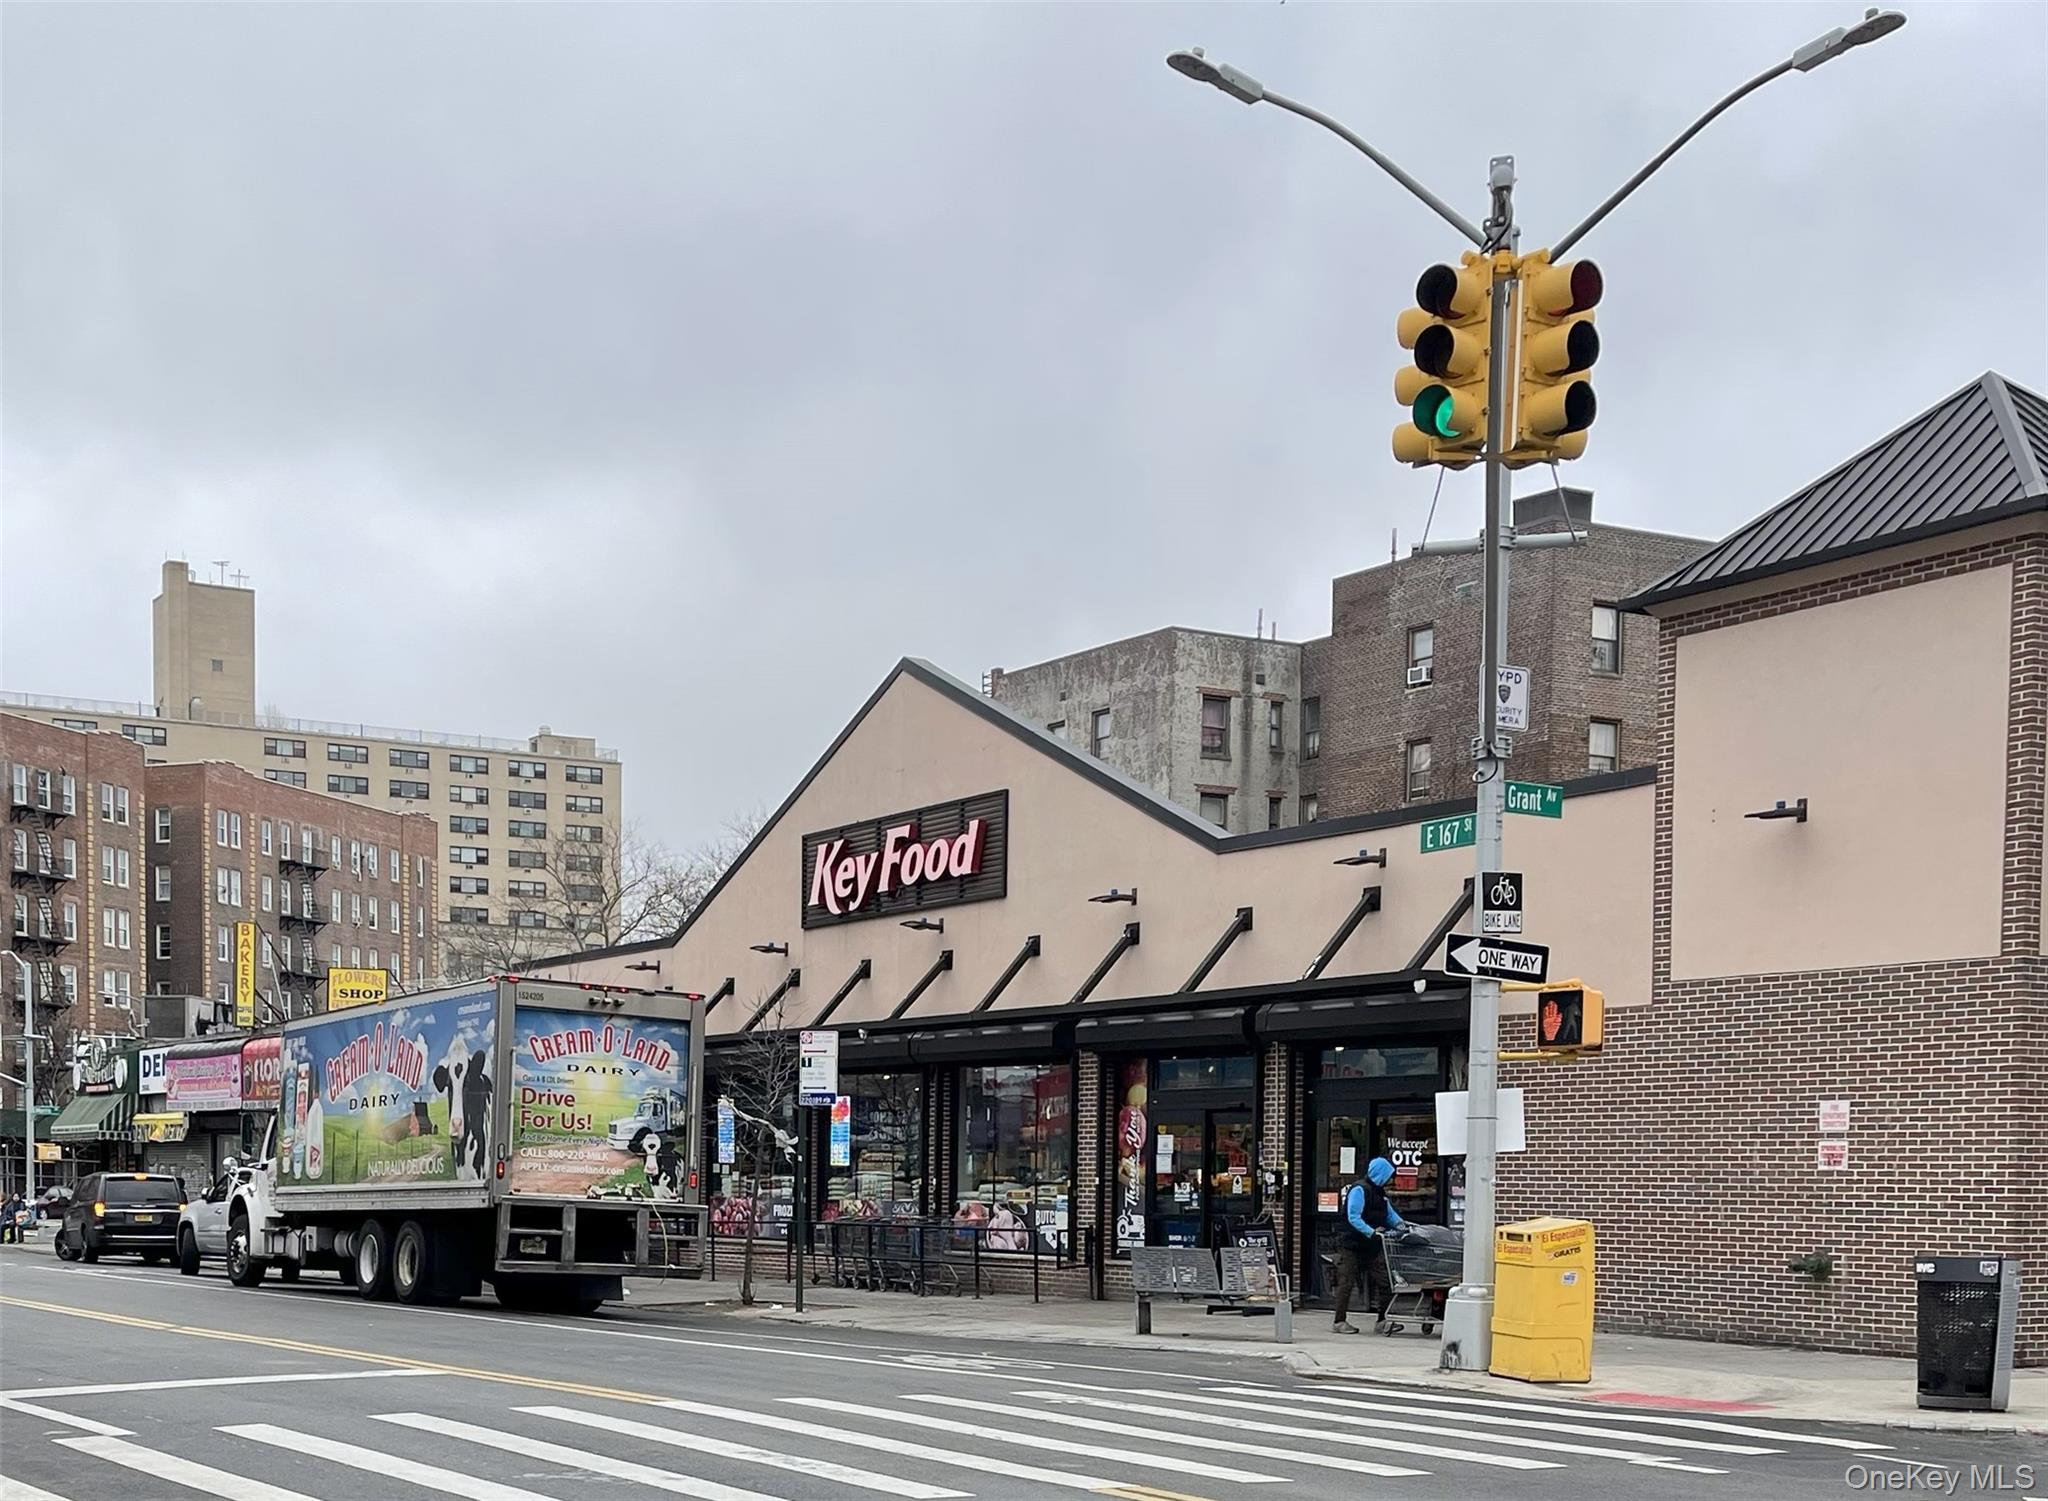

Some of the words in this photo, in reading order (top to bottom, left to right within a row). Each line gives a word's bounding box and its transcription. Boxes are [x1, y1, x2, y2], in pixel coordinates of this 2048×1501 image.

[1497, 671, 1522, 684] YPD
[1498, 716, 1520, 725] MERA
[1508, 785, 1542, 812] Grant
[1546, 791, 1557, 803] Av
[1426, 827, 1434, 848] E
[1438, 822, 1460, 845] 167
[1464, 818, 1473, 833] St
[808, 838, 880, 916] Key
[877, 818, 988, 894] Food
[1484, 913, 1501, 928] BIKE
[1504, 914, 1520, 929] LANE
[240, 924, 252, 1003] BAKERY
[1478, 949, 1506, 968] ONE
[1511, 953, 1540, 972] WAY
[332, 971, 384, 989] FLOWERS
[338, 988, 384, 999] SHOP
[567, 1064, 641, 1076] DAIRY
[349, 1093, 400, 1111] DAIRY
[521, 1087, 576, 1107] Drive
[521, 1110, 555, 1128] For
[561, 1112, 592, 1130] Us!
[1125, 1109, 1142, 1150] You
[547, 1134, 567, 1143] Home
[1387, 1137, 1401, 1148] We
[1401, 1138, 1428, 1151] accept
[1391, 1150, 1422, 1166] OTC
[367, 1160, 406, 1177] NATURALLY
[552, 1163, 625, 1176] creamoland.com
[1124, 1154, 1140, 1207] Thank
[1541, 1233, 1549, 1244] El
[1497, 1243, 1502, 1253] El
[1553, 1246, 1581, 1258] GRATIS
